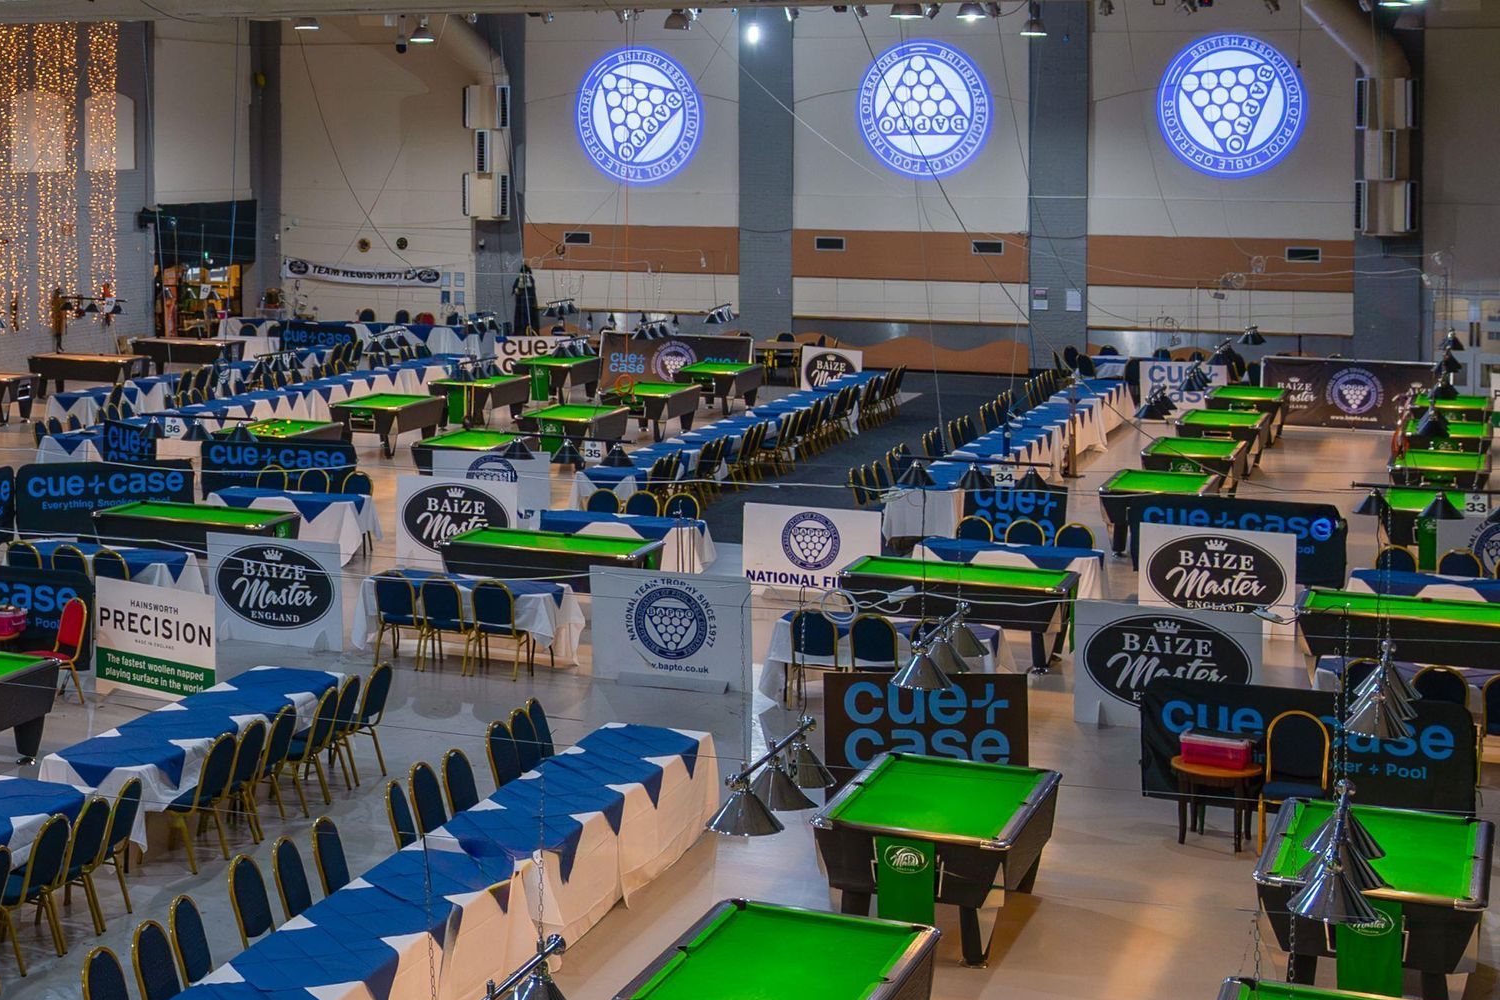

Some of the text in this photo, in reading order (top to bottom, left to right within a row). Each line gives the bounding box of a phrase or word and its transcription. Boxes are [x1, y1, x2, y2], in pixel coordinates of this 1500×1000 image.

[862, 49, 985, 172] BRITISH ASSOCIATION OF POOL TABLE OPERATORS
[1164, 37, 1299, 170] BRITISH ASSOCIATION OF POOL TABLE OPERATORS
[1229, 67, 1272, 150] BAPTO
[580, 52, 698, 179] BRITISH ASSOCIATION OF POOL TABLE OPERATORS
[621, 94, 679, 156] BAPTO
[881, 118, 965, 130] BAPTO
[312, 265, 339, 276] TEAM
[609, 361, 645, 374] case
[610, 353, 645, 363] cue+
[166, 424, 180, 434] 36
[209, 445, 346, 469] cue+case
[586, 449, 600, 458] 35
[28, 471, 184, 498] cue+case
[996, 473, 1013, 482] 34
[427, 497, 485, 515] BAiZE
[1466, 503, 1486, 513] 33
[242, 559, 307, 581] BAiZE
[1178, 550, 1254, 571] BAiZE
[746, 569, 818, 587] NATIONAL
[1165, 566, 1266, 599] Master
[231, 576, 318, 609] Master
[130, 599, 179, 615] HAINSWORTH
[251, 610, 300, 623] ENGLAND
[648, 607, 693, 619] BAPTO
[100, 607, 211, 647] PRECISION
[625, 598, 638, 641] NATIONAL
[697, 594, 716, 622] SINCE
[707, 624, 717, 648] 1977
[1122, 632, 1213, 657] BAiZE
[105, 667, 132, 681] playing
[132, 671, 159, 685] surface
[160, 677, 167, 687] in
[169, 678, 181, 690] the
[107, 653, 204, 682] The fastest woollen napped
[844, 681, 1009, 724] cue+
[844, 728, 1011, 769] case
[1386, 763, 1427, 779] Pool
